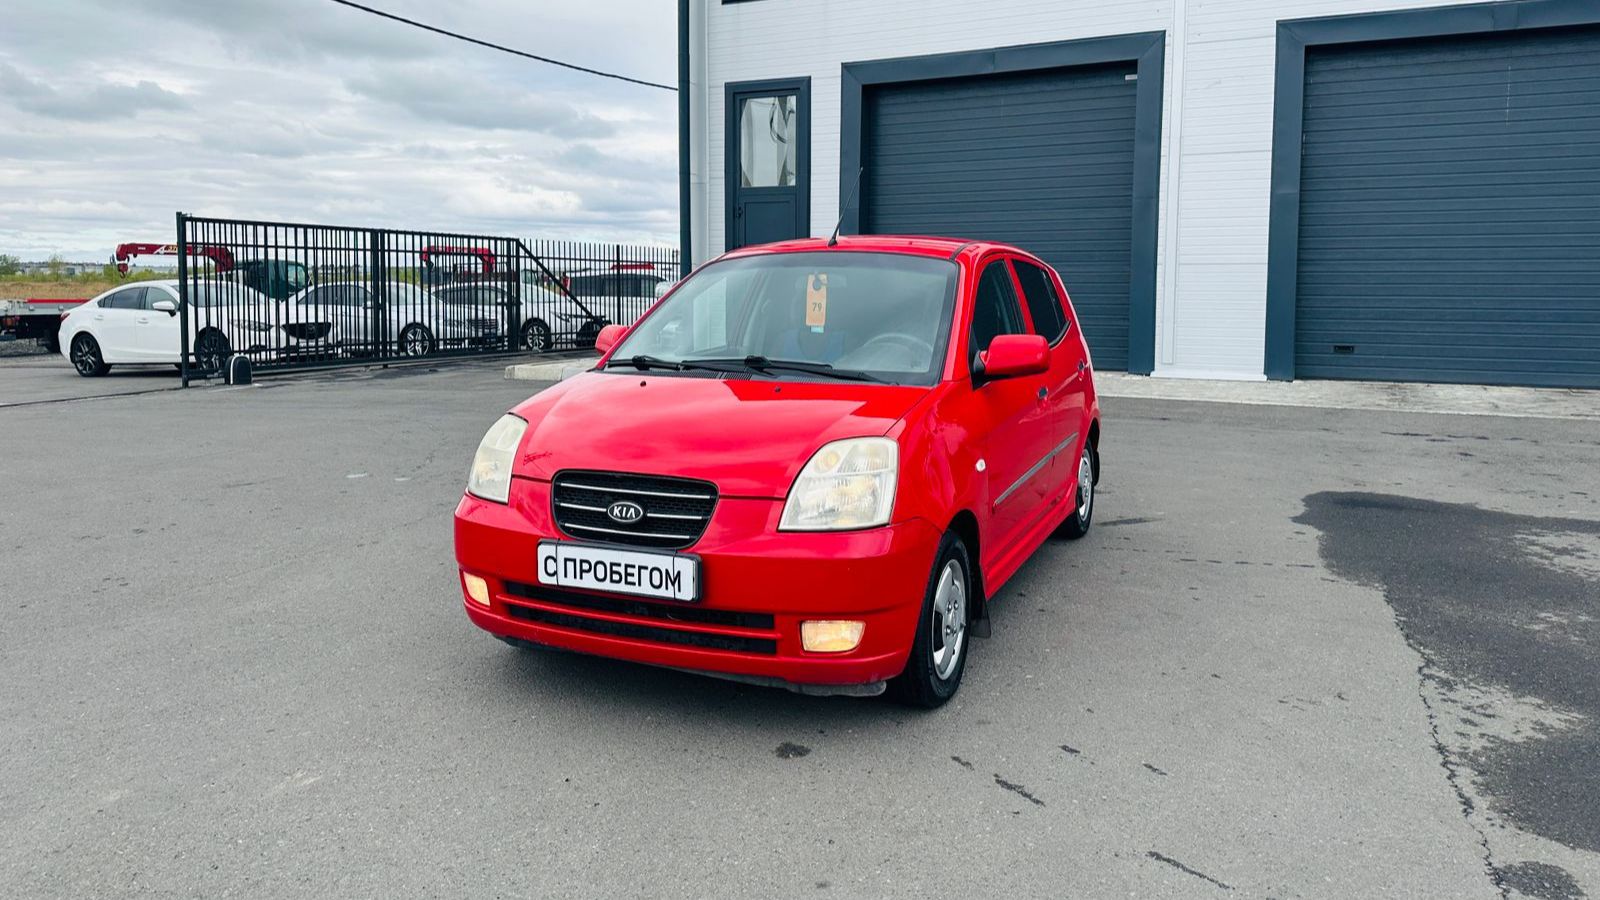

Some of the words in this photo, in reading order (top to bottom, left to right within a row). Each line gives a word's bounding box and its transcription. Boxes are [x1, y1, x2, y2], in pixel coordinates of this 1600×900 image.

[613, 505, 636, 519] KIA
[544, 555, 557, 577] С
[563, 557, 681, 592] ПРОБЕГОМ
